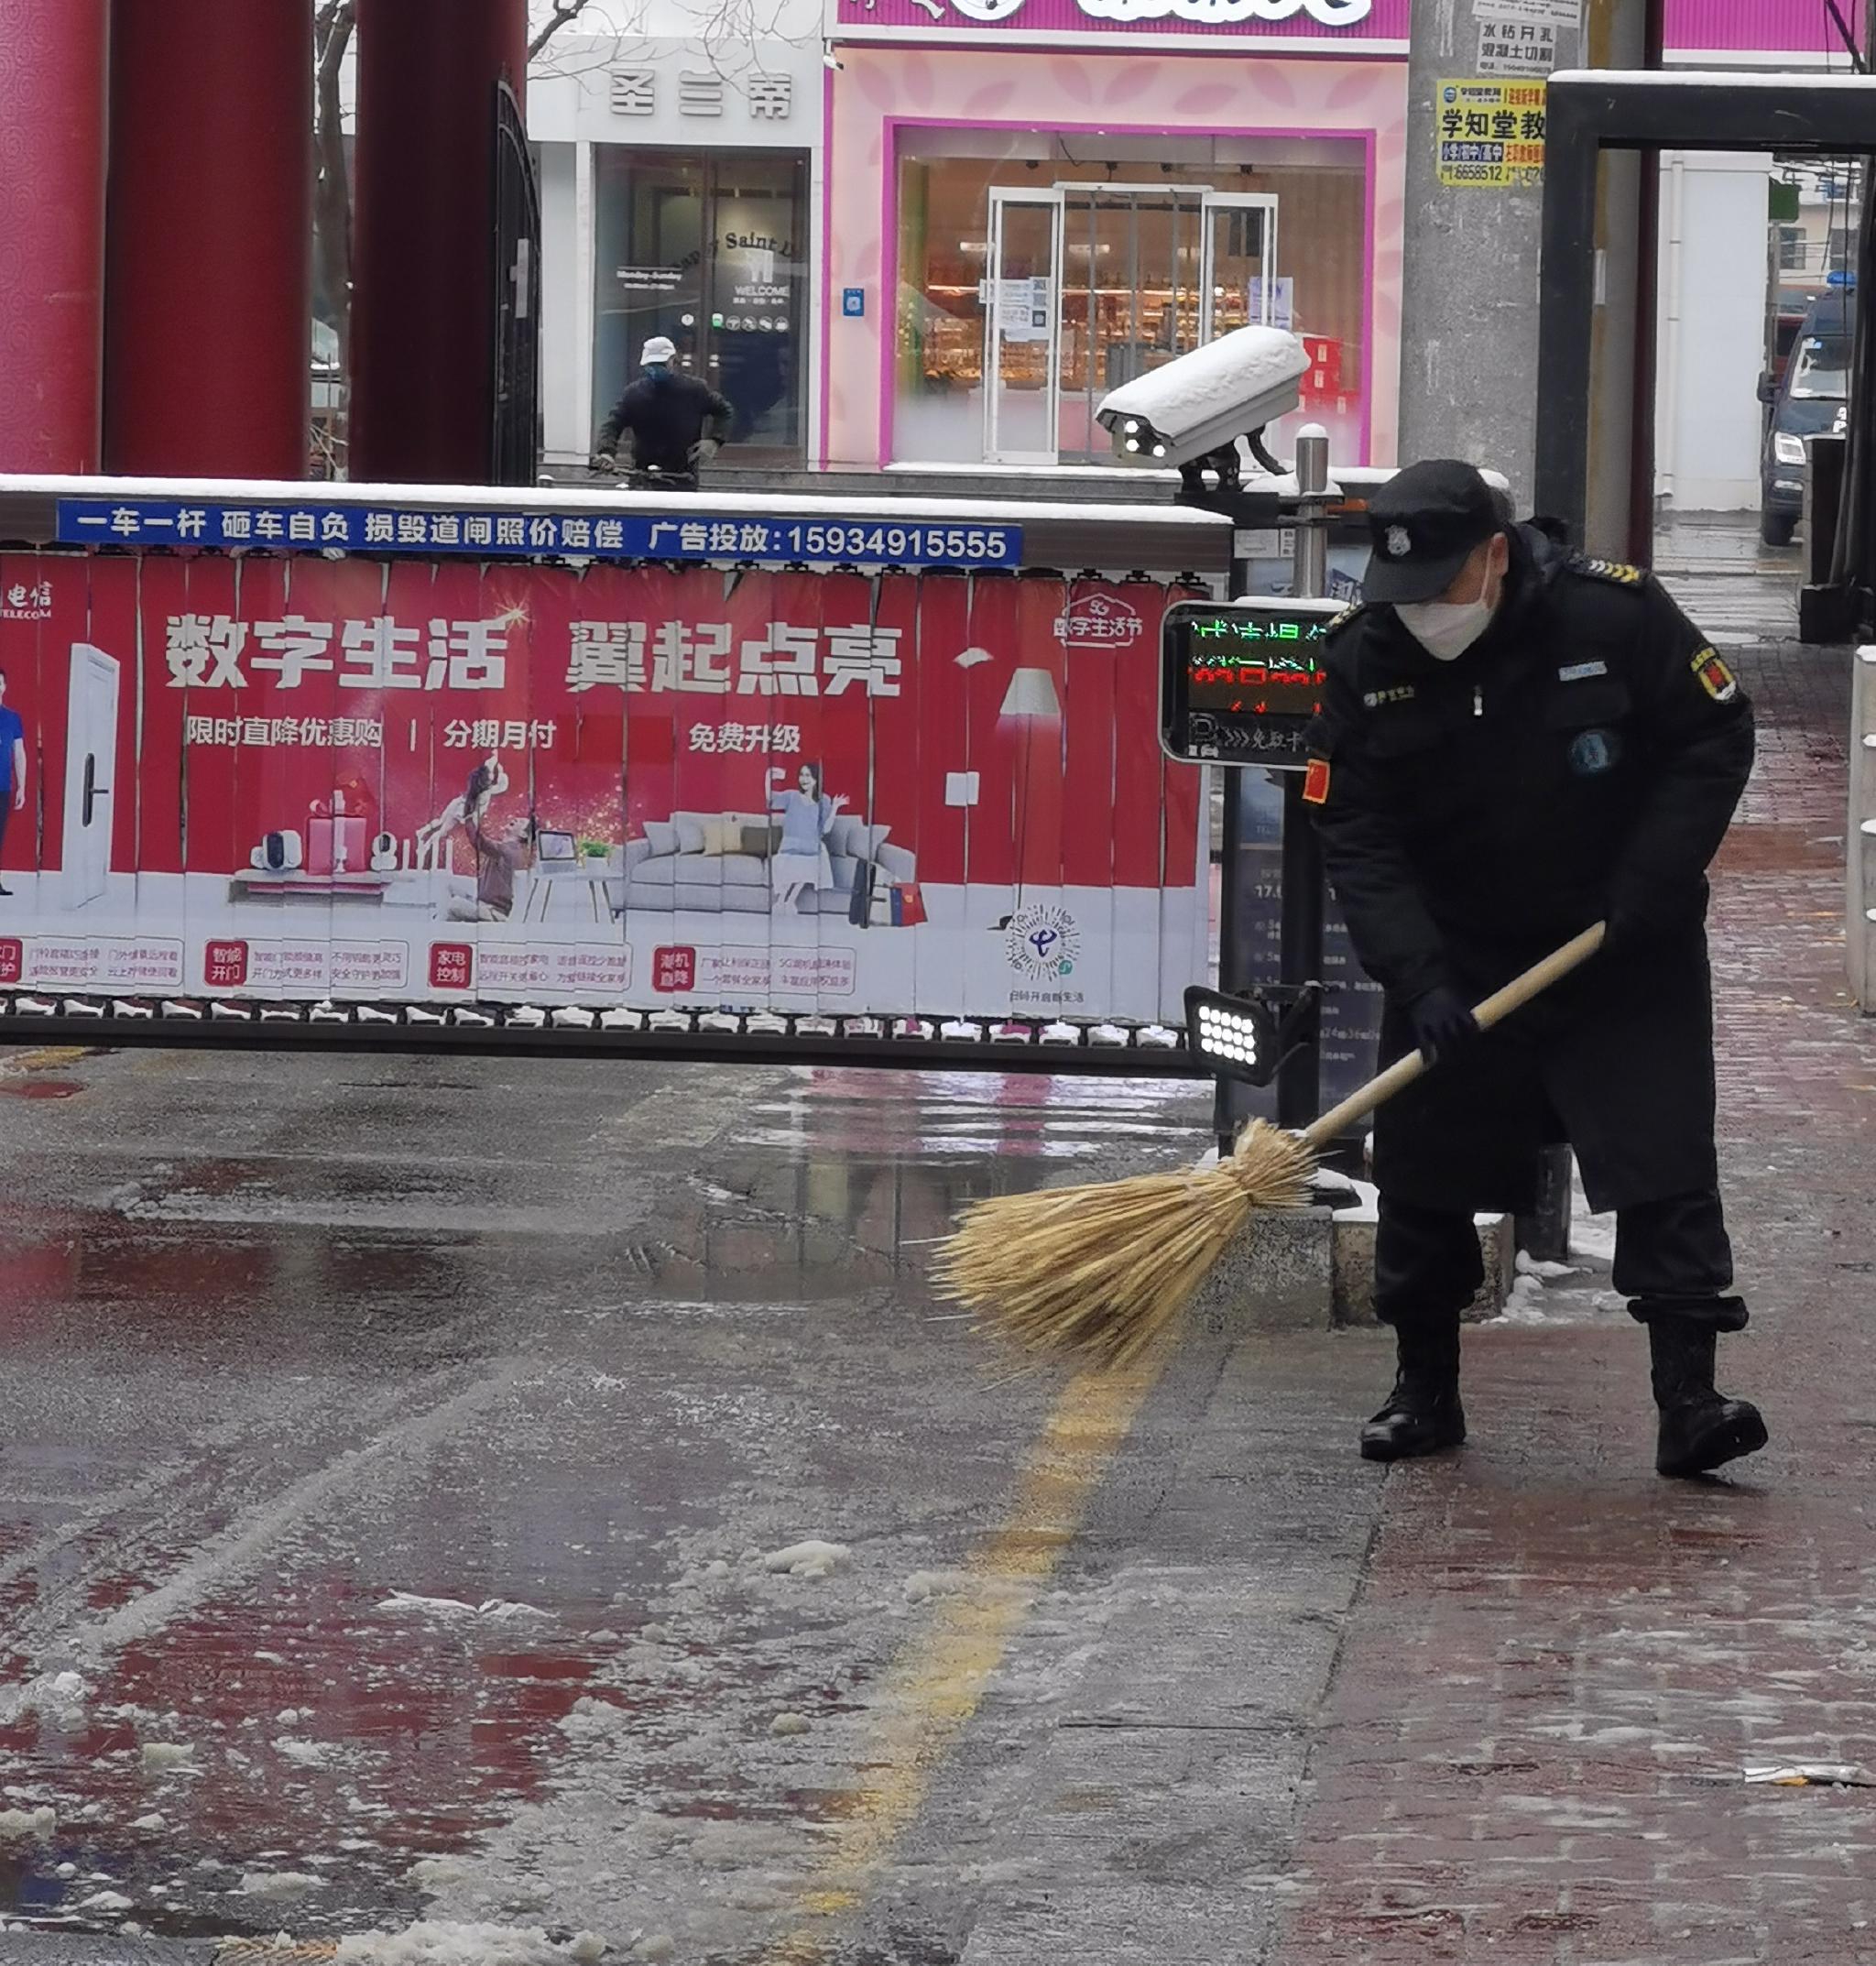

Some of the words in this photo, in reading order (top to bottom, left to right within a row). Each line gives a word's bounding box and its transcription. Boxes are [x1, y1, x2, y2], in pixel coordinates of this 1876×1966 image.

[1483, 24, 1553, 42] 水钻开孔
[735, 285, 791, 298] WELCOME
[77, 507, 206, 538] 一车一杆
[222, 511, 349, 541] 砸车自负
[365, 513, 624, 549] 损毁道闸照价赔偿
[7, 580, 53, 608] 电信
[166, 615, 507, 690] 数字生活
[565, 621, 902, 697] 翼起点亮
[187, 715, 383, 748] 限时直降优惠购
[443, 719, 557, 749] 分期月付
[689, 723, 801, 753] 免费升级
[213, 947, 243, 963] 智能
[438, 950, 466, 966] 家电
[212, 965, 241, 981] 开门
[436, 967, 465, 983] 控制
[660, 970, 689, 987] 直降
